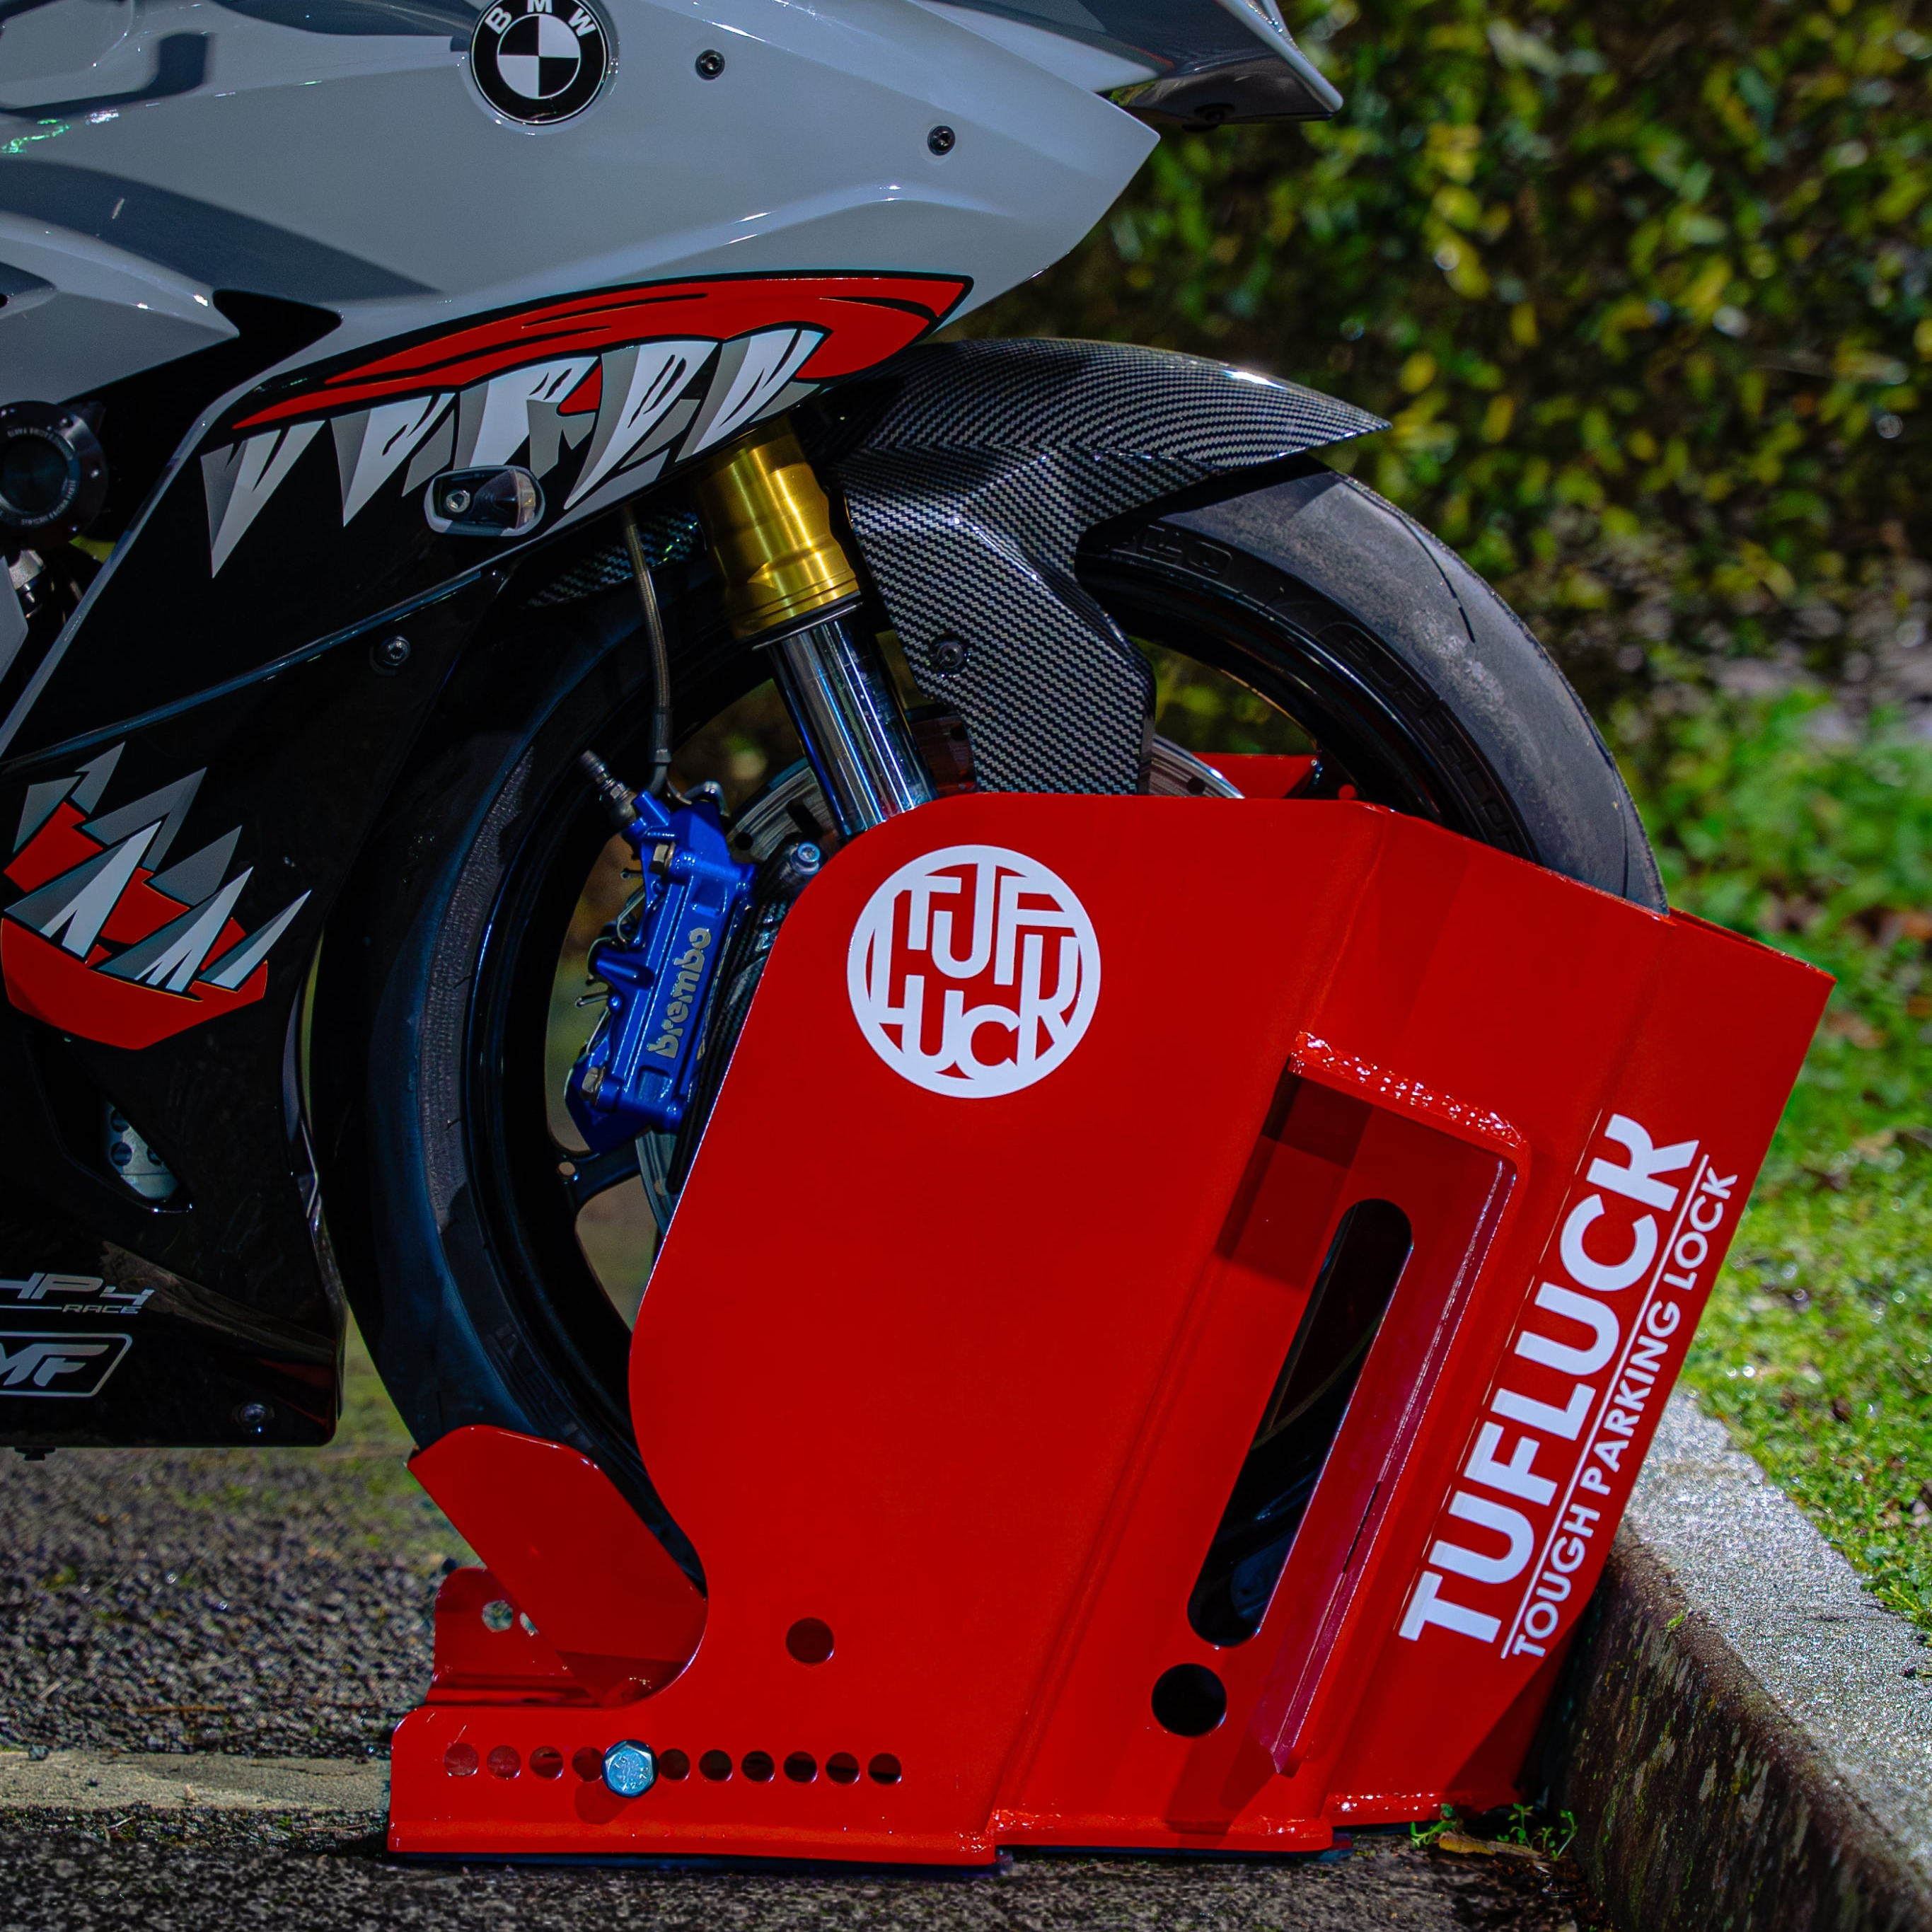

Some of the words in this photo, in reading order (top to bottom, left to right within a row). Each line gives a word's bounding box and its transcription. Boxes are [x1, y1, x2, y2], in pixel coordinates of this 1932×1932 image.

[484, 0, 597, 37] BMW
[647, 927, 712, 1059] brembo
[62, 1304, 142, 1314] RACE
[1398, 1113, 1699, 1643] TUFLUCK
[1512, 1504, 1601, 1658] TOUGH
[1586, 1300, 1681, 1496] PARKING
[1662, 1167, 1737, 1291] LOCK
